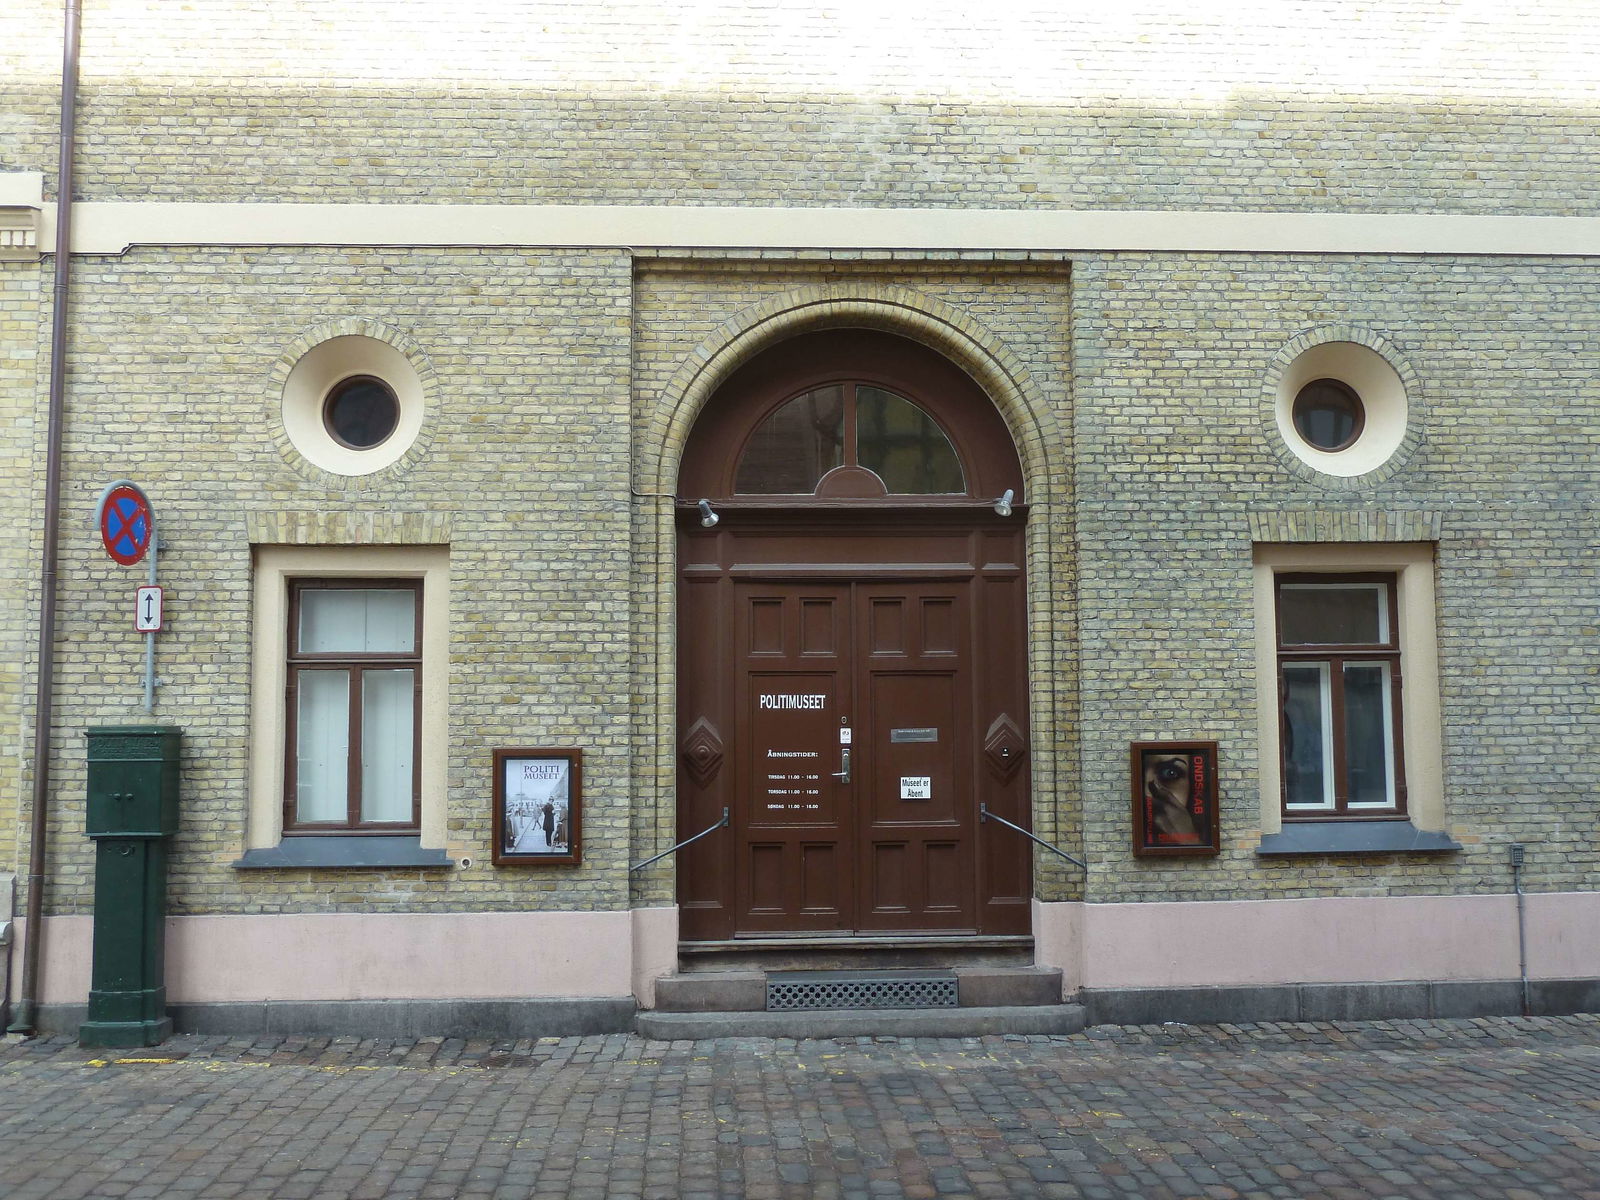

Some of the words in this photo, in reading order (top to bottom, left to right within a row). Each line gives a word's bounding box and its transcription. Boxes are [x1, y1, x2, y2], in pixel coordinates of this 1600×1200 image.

[760, 694, 826, 708] POLITIMUSEET
[768, 750, 818, 758] ÅBNINGSTIDER:
[1194, 756, 1203, 814] ONDSKAB
